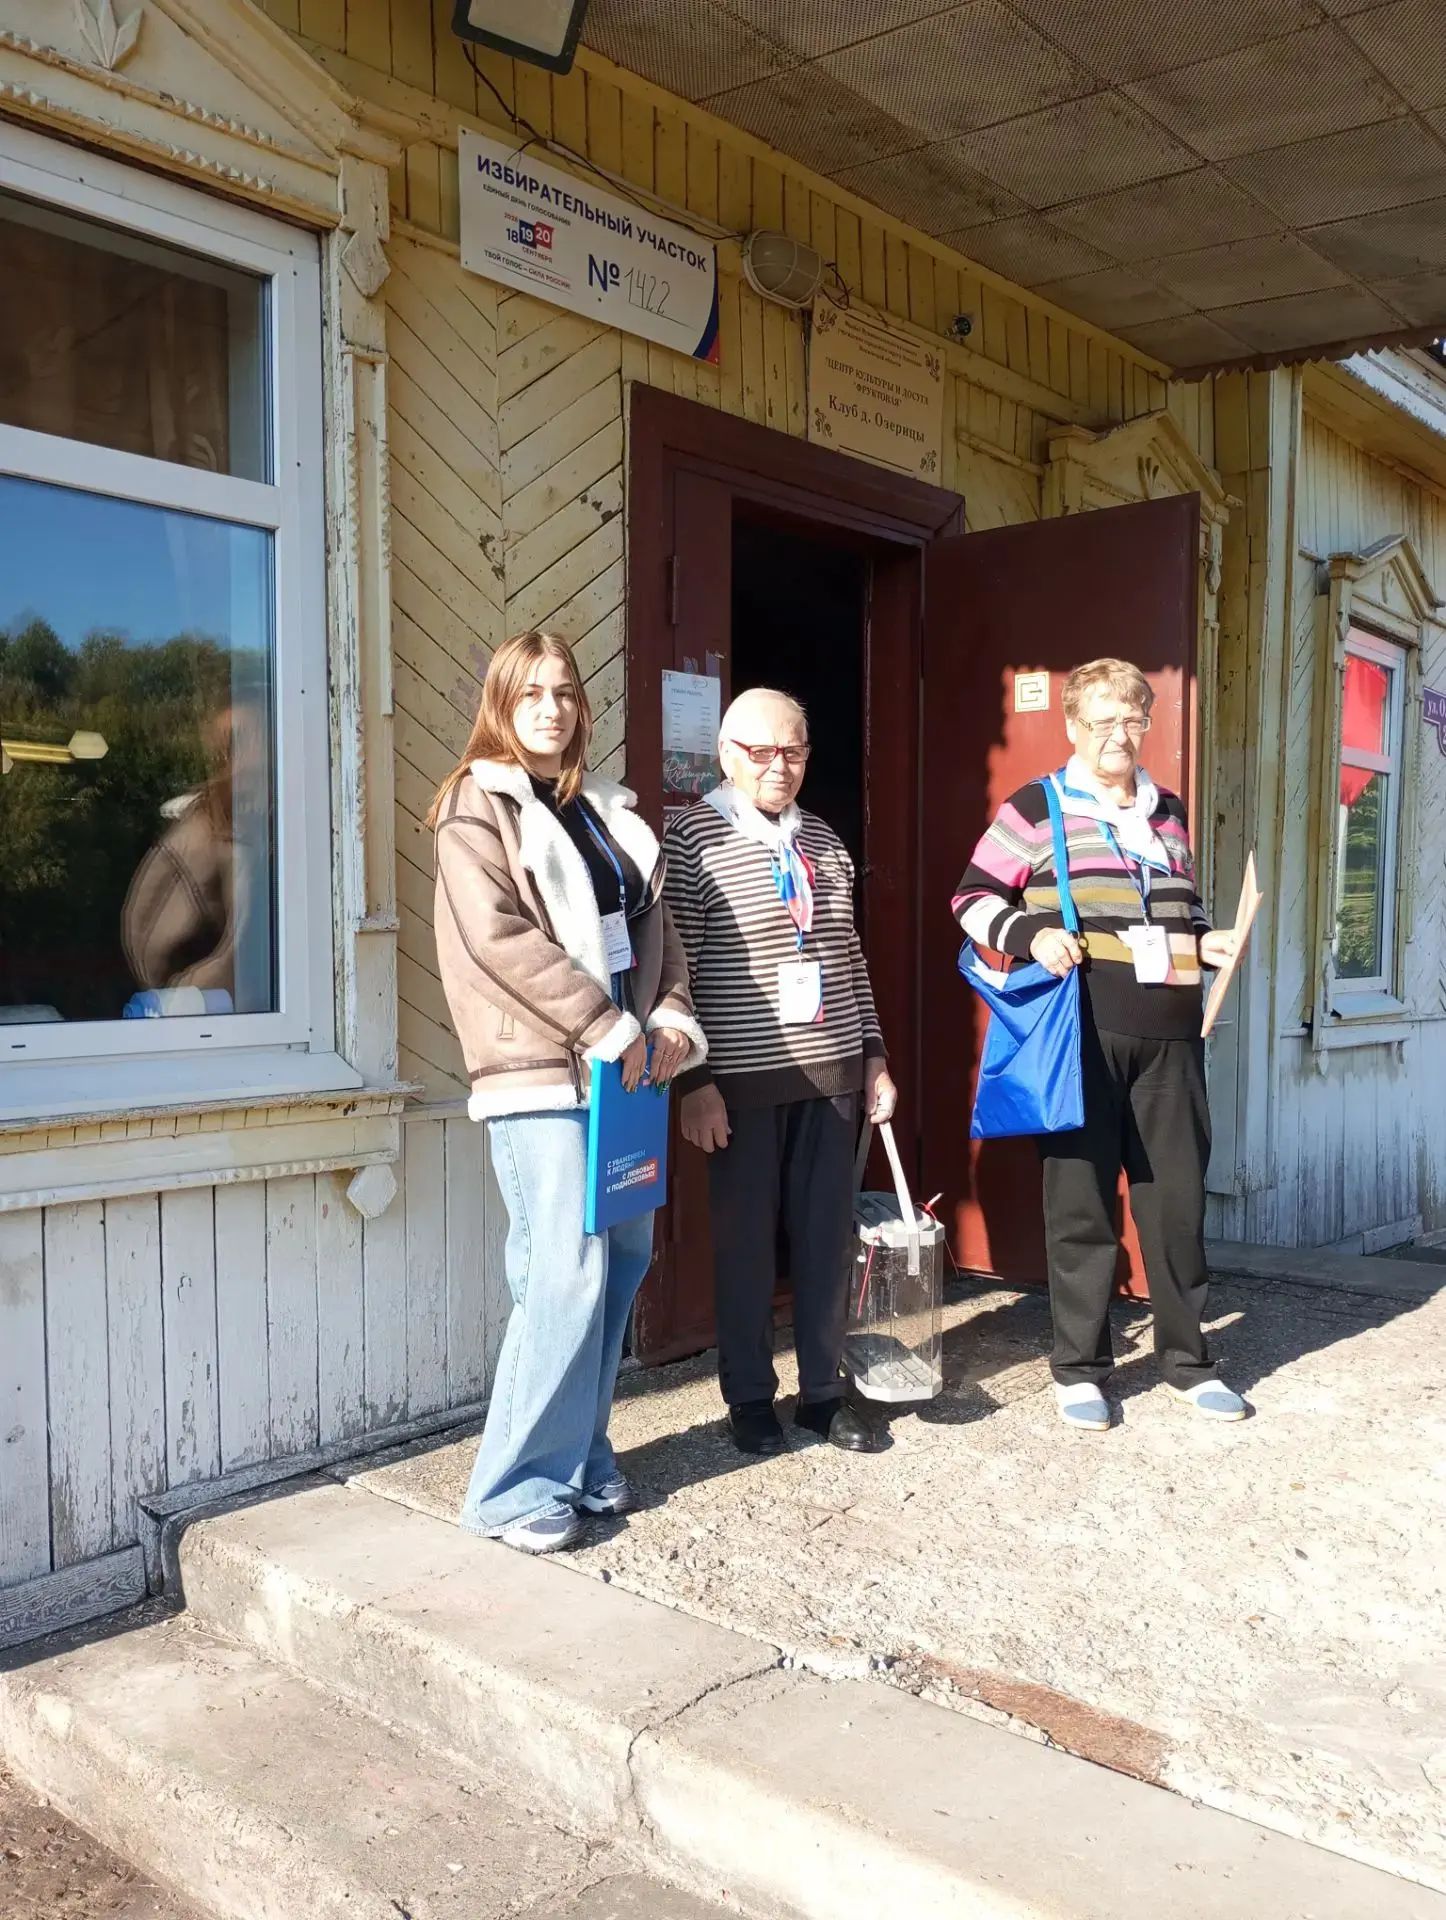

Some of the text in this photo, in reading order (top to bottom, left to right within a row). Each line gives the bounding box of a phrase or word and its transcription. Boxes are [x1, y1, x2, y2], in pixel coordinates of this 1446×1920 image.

[477, 155, 707, 273] ИЗБИРАТЕЛЬНЫЙ УЧАСТОК
[506, 226, 550, 243] 18 19 20
[484, 249, 501, 262] ТВОЙ
[502, 256, 522, 270] ГОЛОС
[528, 268, 545, 279] СИЛА
[522, 246, 553, 264] СЕНТЯБРЯ
[588, 254, 671, 315] № 1422
[855, 369, 893, 392] КУЛЬТУРЫ
[829, 394, 925, 443] Клуб д. Озерицы
[1440, 698, 1446, 718] О
